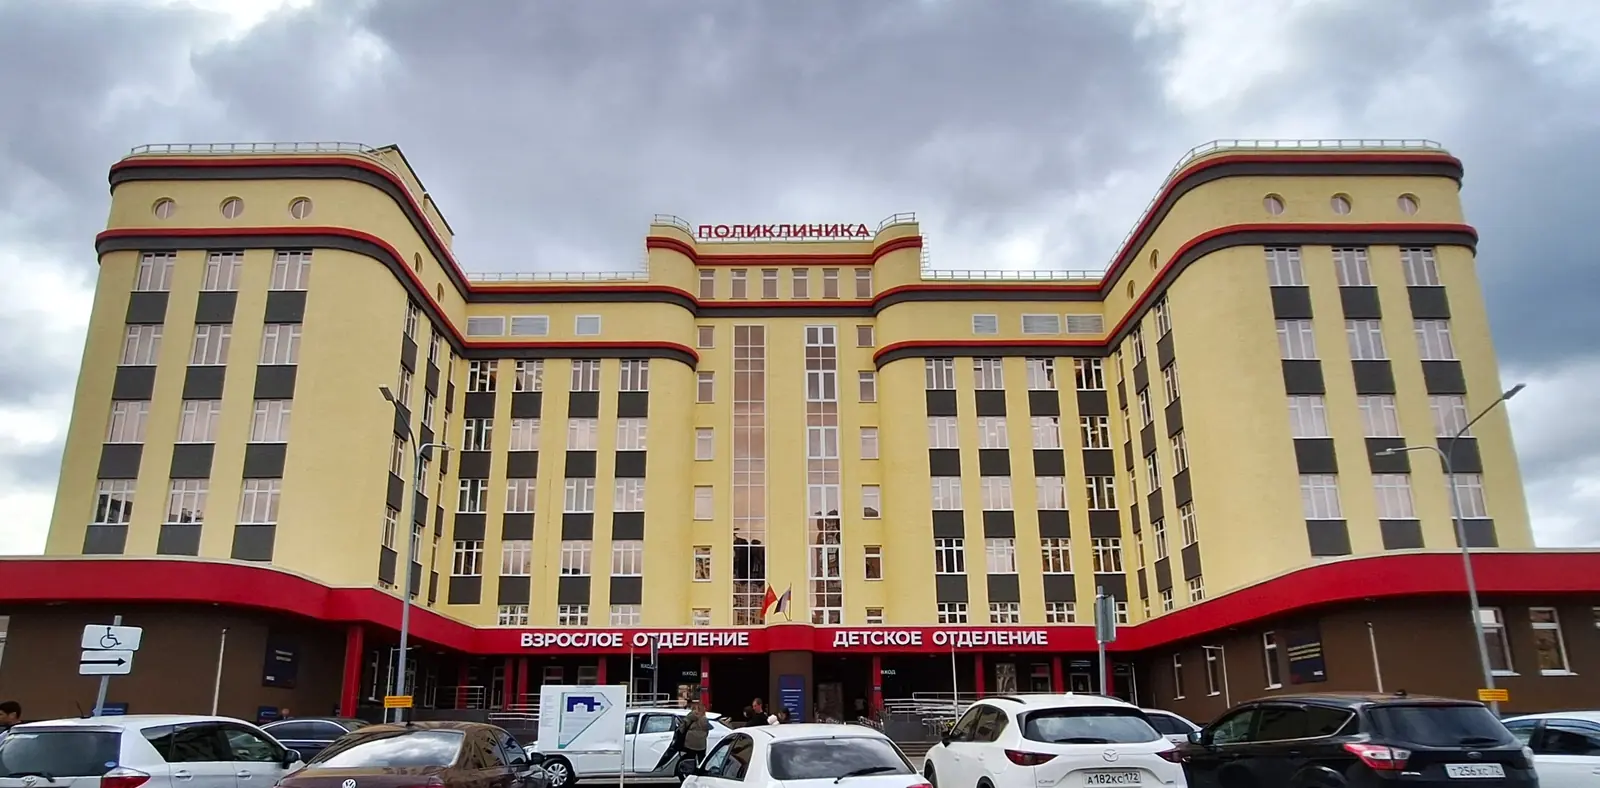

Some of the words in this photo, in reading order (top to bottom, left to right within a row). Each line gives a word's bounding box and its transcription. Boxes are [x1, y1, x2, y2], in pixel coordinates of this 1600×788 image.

[698, 223, 870, 238] ПОЛИКЛИНИКА
[520, 632, 623, 648] ВЗРОСЛОЕ
[833, 630, 923, 648] ДЕТСКОЕ
[932, 630, 1048, 648] ОТДЕЛЕНИЕ
